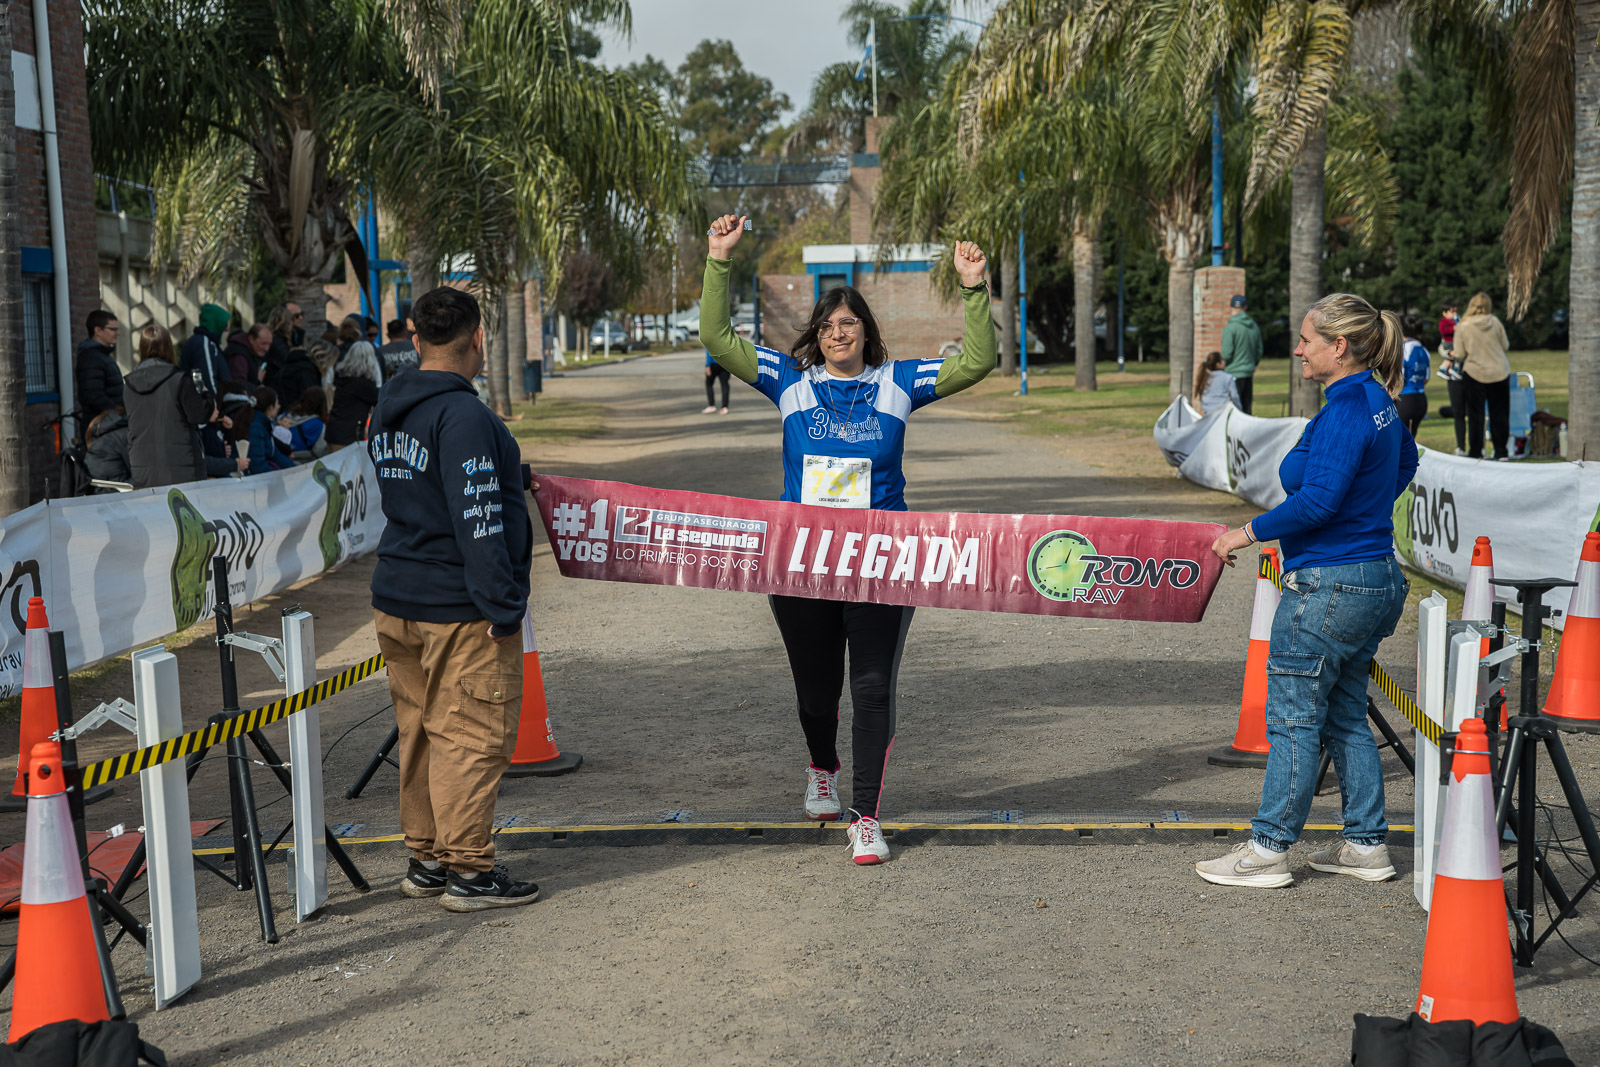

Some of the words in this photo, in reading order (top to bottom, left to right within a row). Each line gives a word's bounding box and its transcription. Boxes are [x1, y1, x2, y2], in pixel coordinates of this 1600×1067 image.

[807, 407, 830, 440] 3
[464, 480, 476, 496] de
[463, 504, 483, 520] más
[552, 499, 609, 540] #1
[656, 513, 691, 525] GRUPO
[692, 517, 762, 532] ASEGURADOR
[473, 521, 488, 540] del
[654, 524, 675, 541] La
[676, 527, 760, 550] segunda
[557, 539, 608, 564] VOS
[616, 547, 635, 561] LO
[638, 549, 697, 567] PRIMERO
[701, 554, 728, 570] SOS
[731, 558, 759, 572] VOS
[787, 526, 981, 586] LLEGADA
[1071, 586, 1126, 605] RAV
